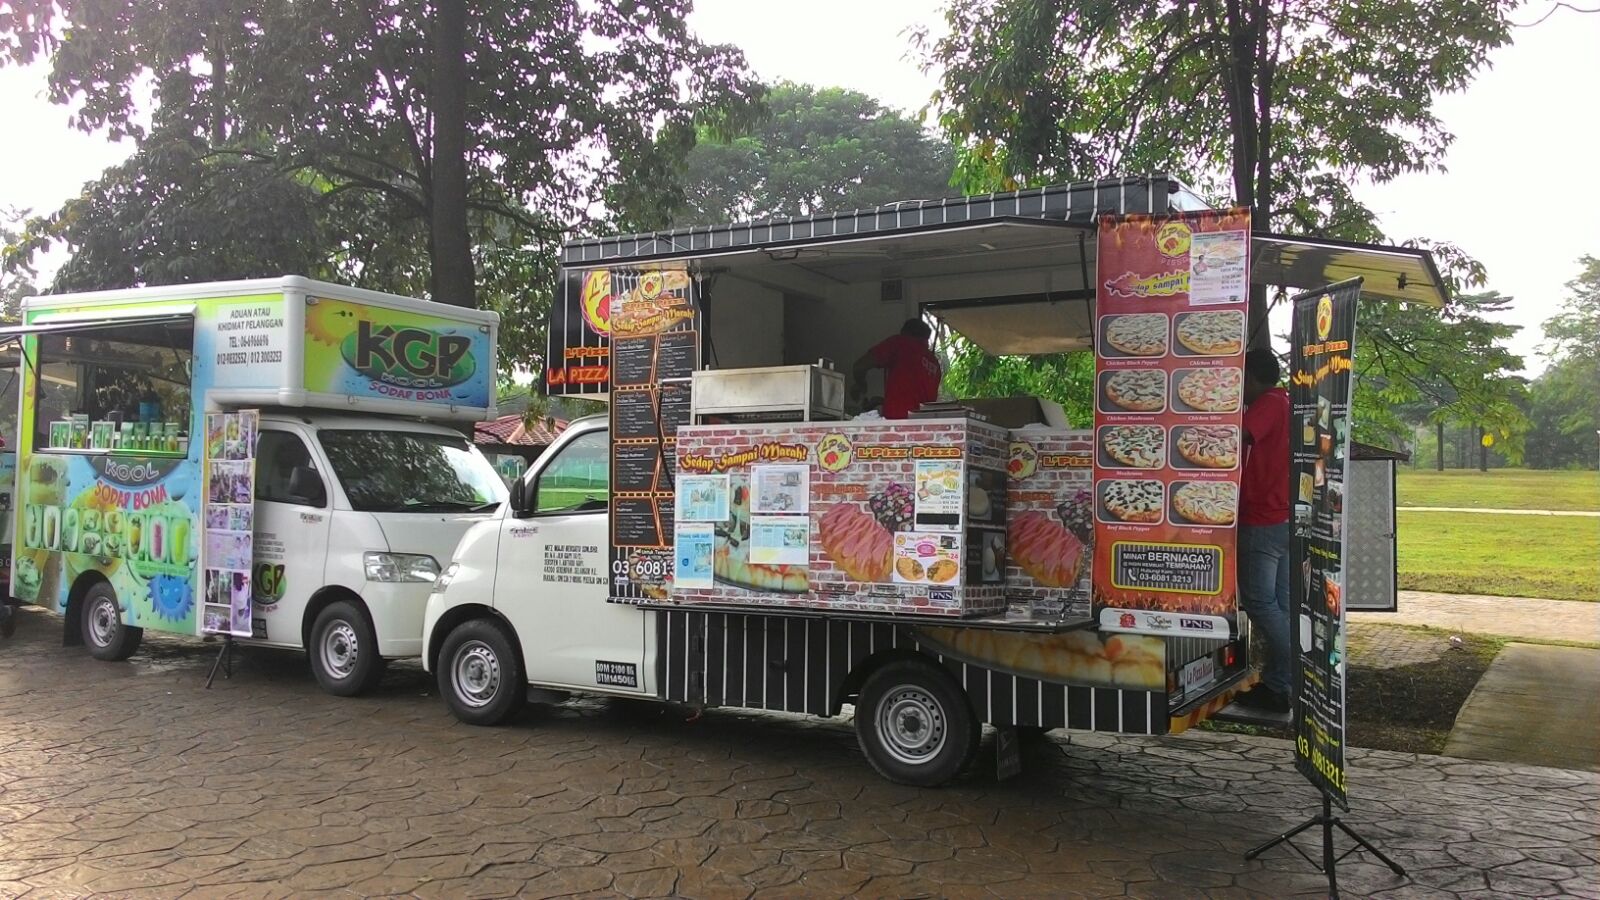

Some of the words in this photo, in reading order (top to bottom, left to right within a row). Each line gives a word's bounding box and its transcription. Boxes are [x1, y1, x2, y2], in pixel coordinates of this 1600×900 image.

[1153, 277, 1183, 290] sampai
[230, 308, 252, 319] ADUAN
[253, 307, 271, 317] ATAU
[217, 321, 245, 331] KHIDMAT
[246, 318, 284, 330] PELANGGAN
[355, 319, 473, 379] KGP
[250, 351, 260, 364] 012
[381, 372, 443, 388] KOOL
[548, 368, 567, 384] LA
[368, 381, 414, 400] SODAP
[416, 389, 453, 401] BONA
[681, 452, 716, 474] Sedap
[716, 444, 760, 473] Sampai
[760, 440, 808, 462] Marah!
[856, 446, 909, 459] L'Pizz
[912, 446, 962, 459] Pizza
[104, 457, 160, 482] KOOL
[95, 480, 132, 510] SODAP
[133, 483, 167, 511] BONA
[1122, 552, 1147, 561] MINAT
[1147, 551, 1212, 564] BERNIAGA?
[612, 559, 630, 574] 03
[1165, 561, 1212, 571] TEMPAHAN?
[1139, 572, 1170, 582] 03-6081
[1172, 574, 1193, 584] 3213
[930, 591, 953, 600] PNS
[1180, 618, 1214, 629] PNS
[610, 664, 626, 675] 2100
[1297, 734, 1309, 758] 03
